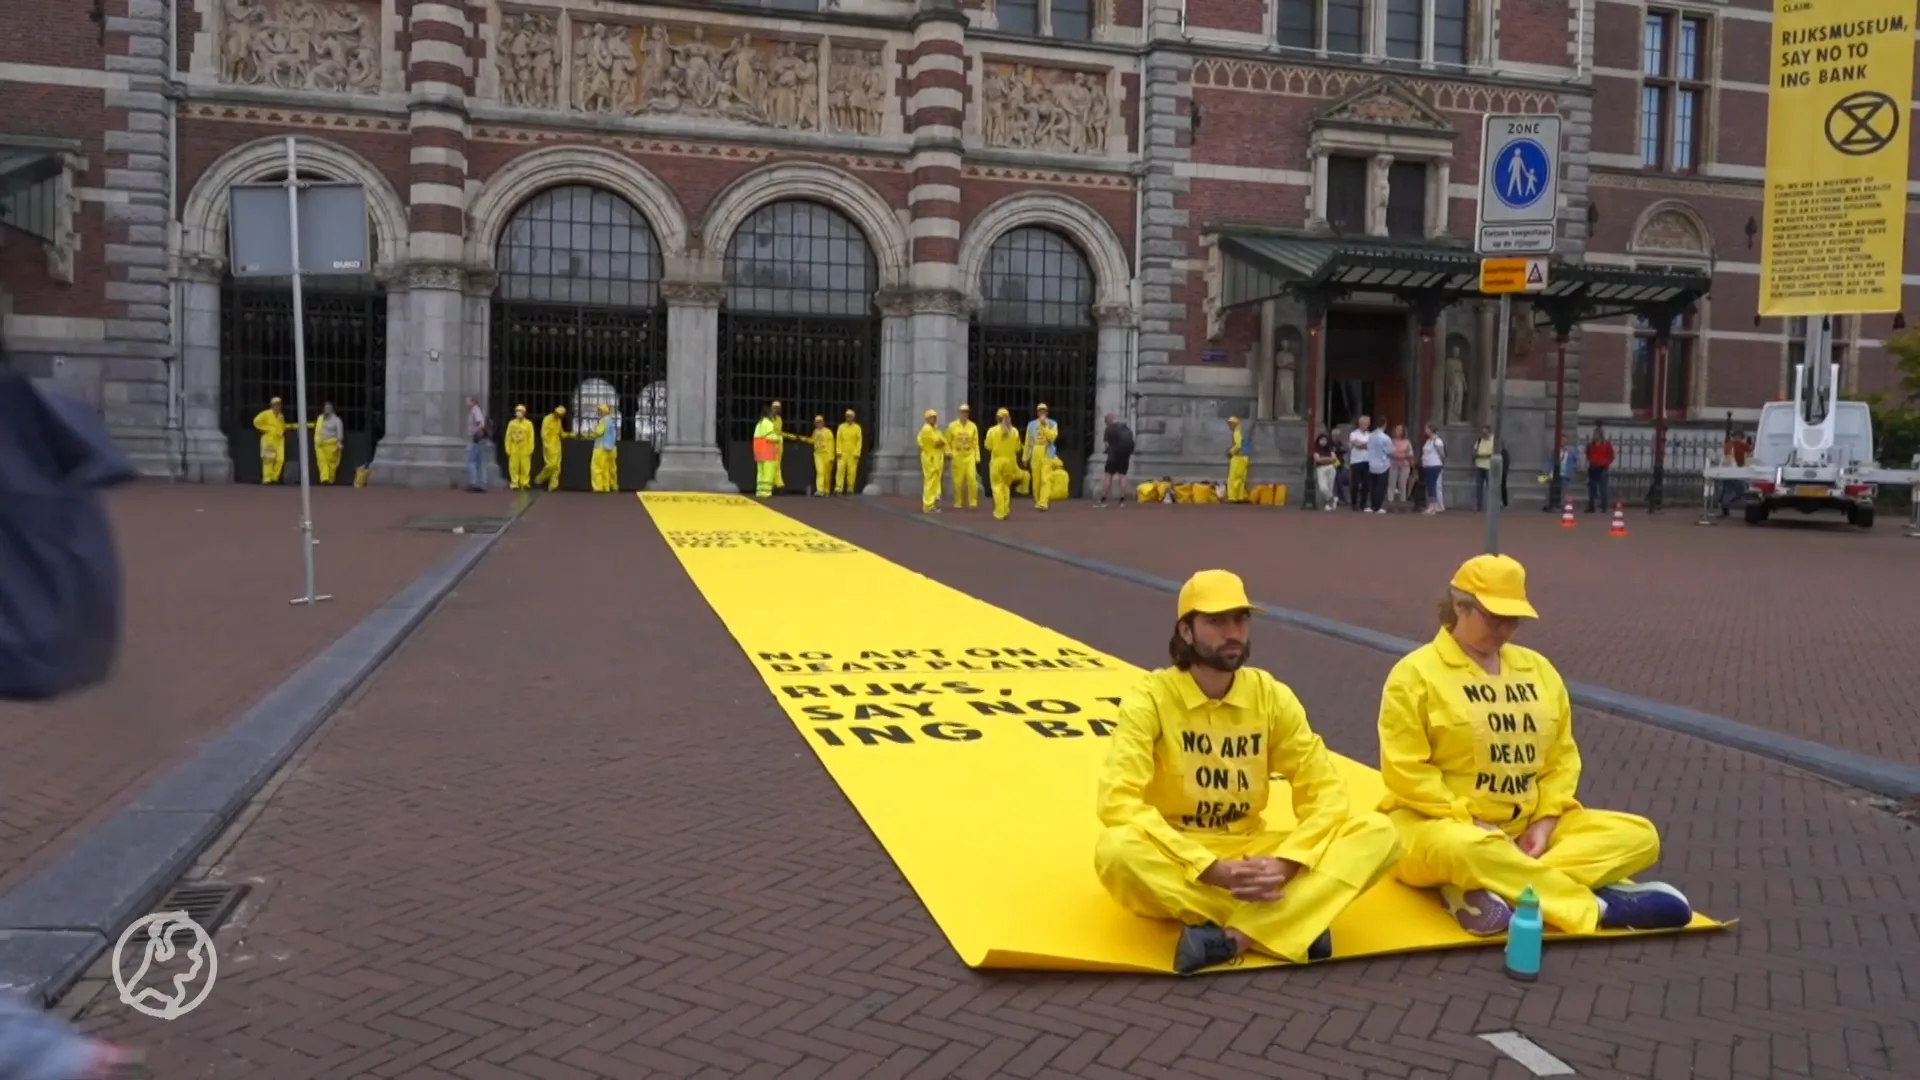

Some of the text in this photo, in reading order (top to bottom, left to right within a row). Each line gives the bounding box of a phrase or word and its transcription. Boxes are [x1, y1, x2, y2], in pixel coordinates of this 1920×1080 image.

[1782, 15, 1908, 46] RIJKSMUSEUM,
[1781, 42, 1869, 67] SAY NO TO
[1780, 64, 1868, 88] ING BANK
[1507, 123, 1541, 134] ZONE
[757, 647, 1090, 661] NO ART ON A
[769, 657, 1107, 673] DEAD PLANET
[1463, 683, 1538, 703] NO ART
[800, 701, 936, 721] SAY
[966, 698, 1082, 716] NO
[813, 718, 1121, 747] ING BA
[1487, 712, 1537, 733] ON A
[1182, 731, 1262, 758] NO ART
[1490, 743, 1536, 764] DEAD
[1196, 766, 1249, 792] ON A
